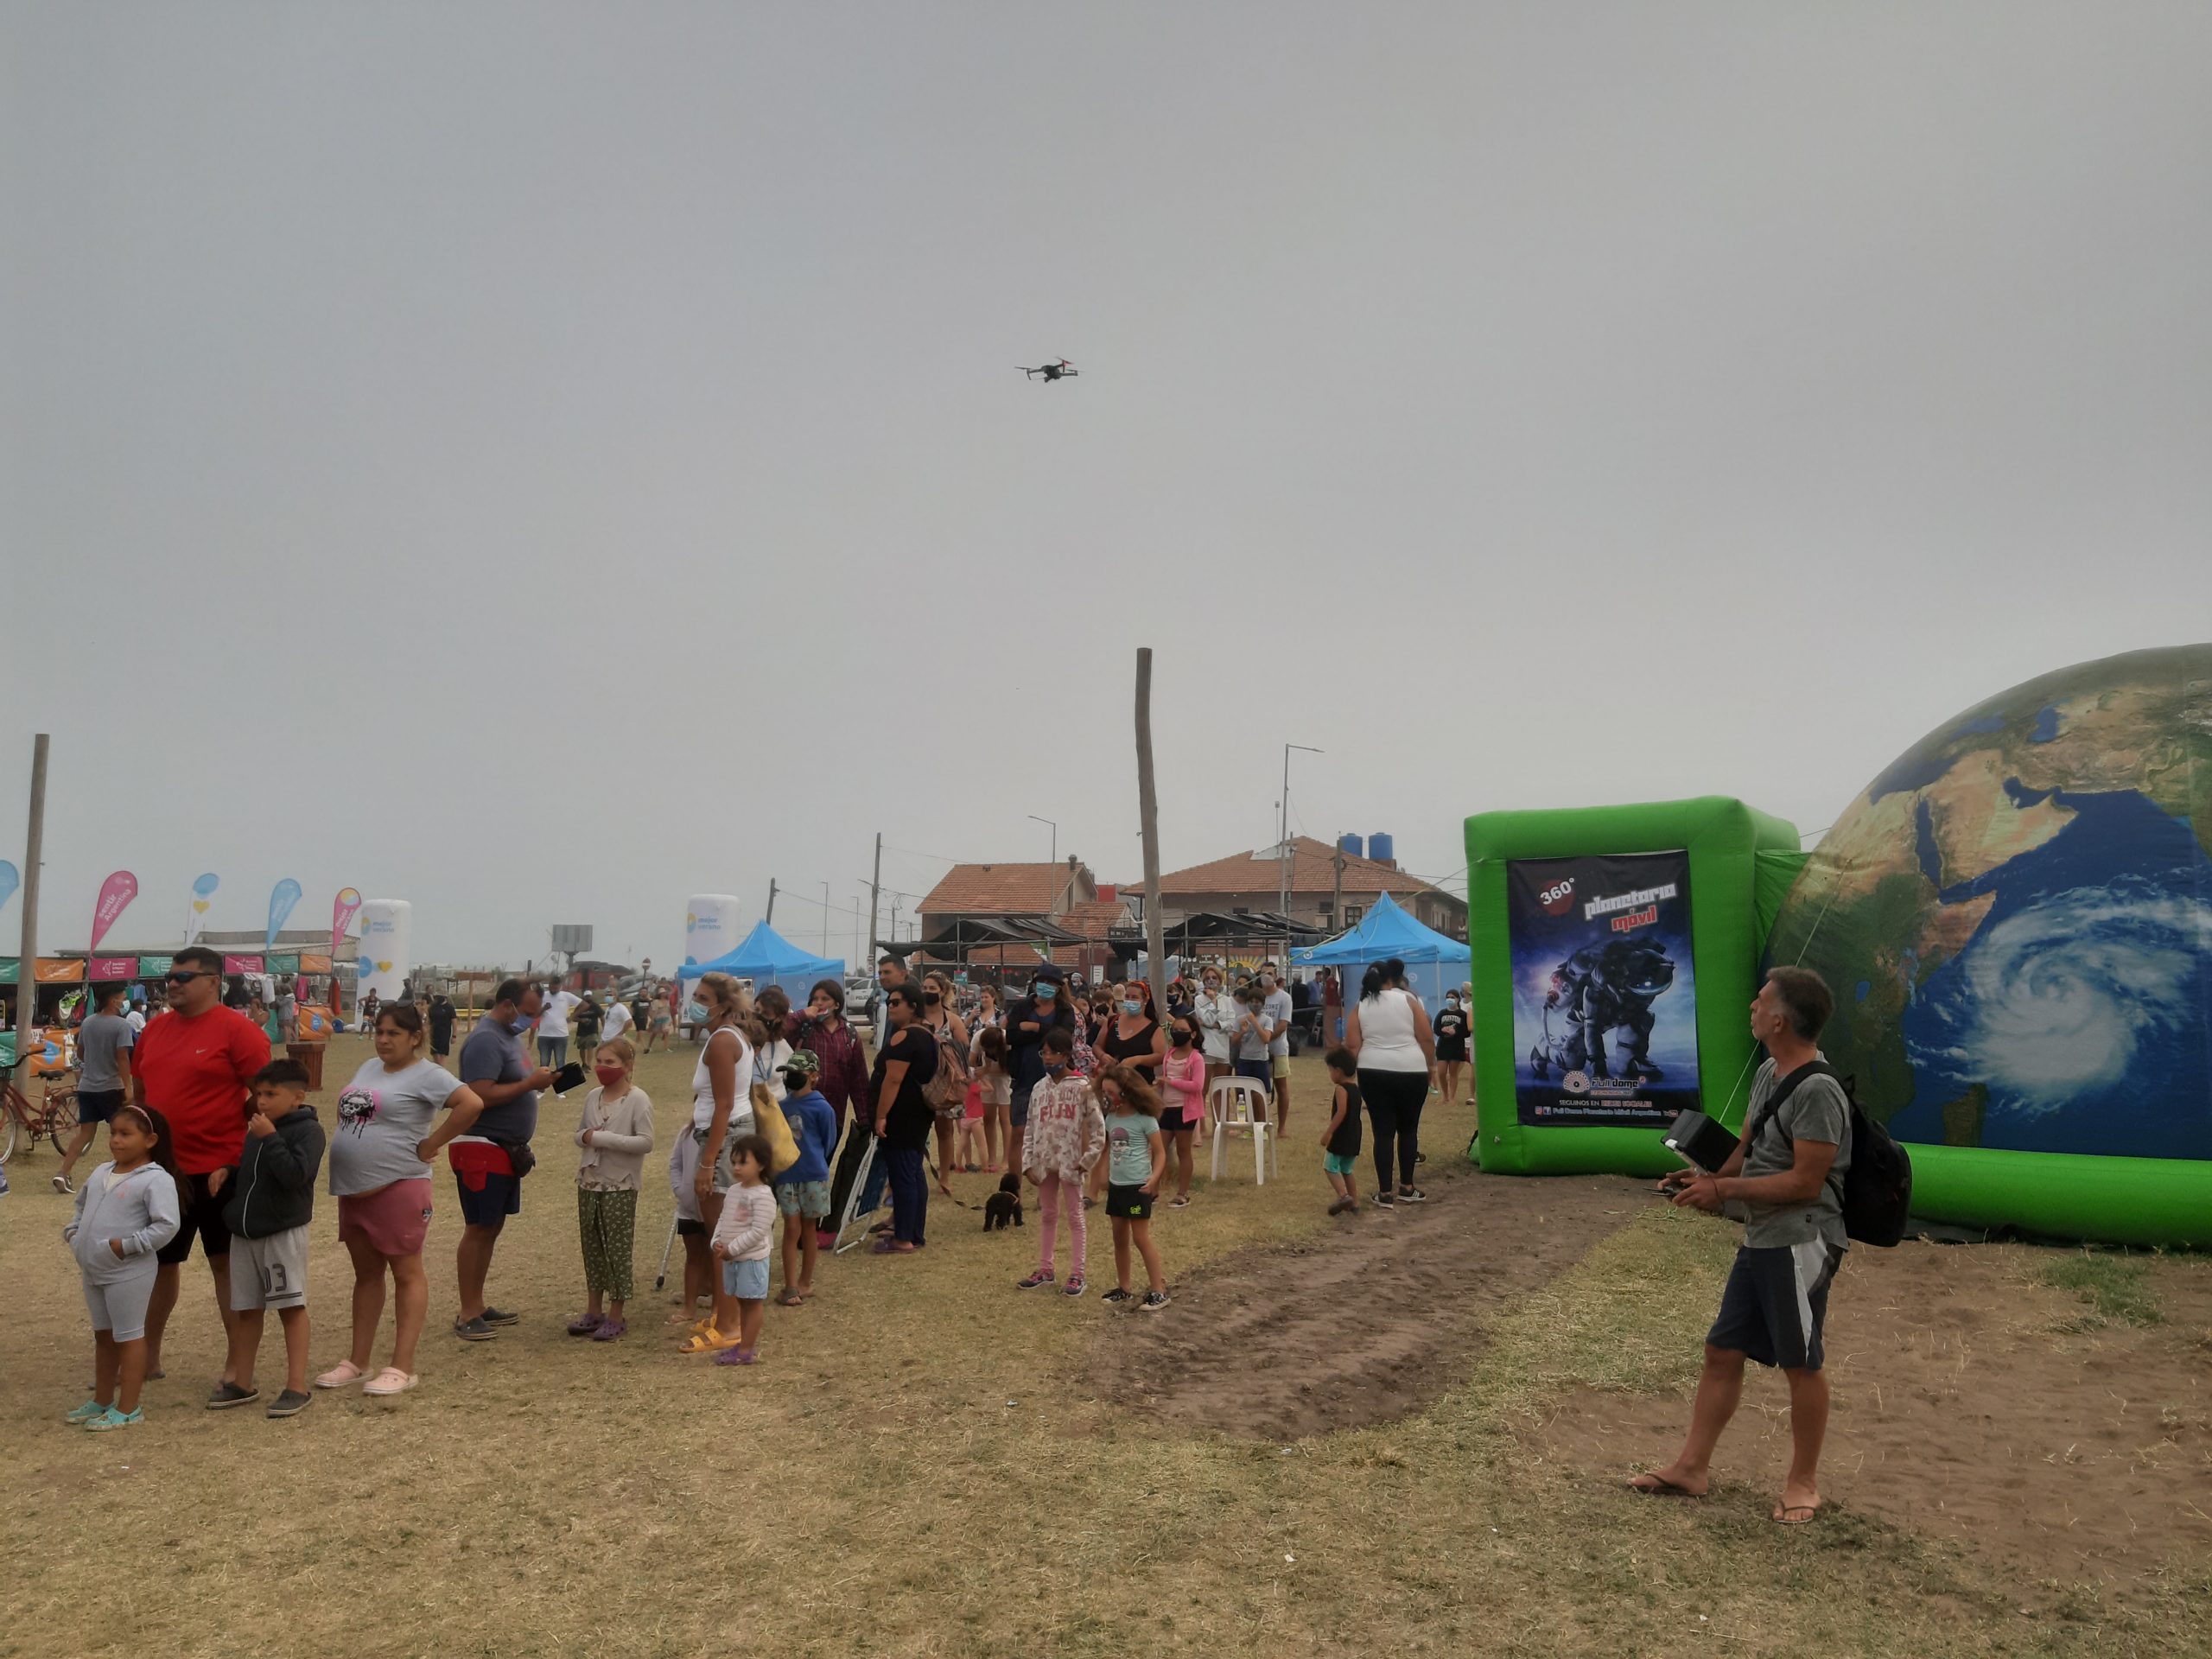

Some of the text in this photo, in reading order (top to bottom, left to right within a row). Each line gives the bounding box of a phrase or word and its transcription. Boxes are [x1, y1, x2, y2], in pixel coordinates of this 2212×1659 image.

[1540, 877, 1574, 906] 360°
[1585, 883, 1678, 921] planetario
[1611, 906, 1658, 932] móvil
